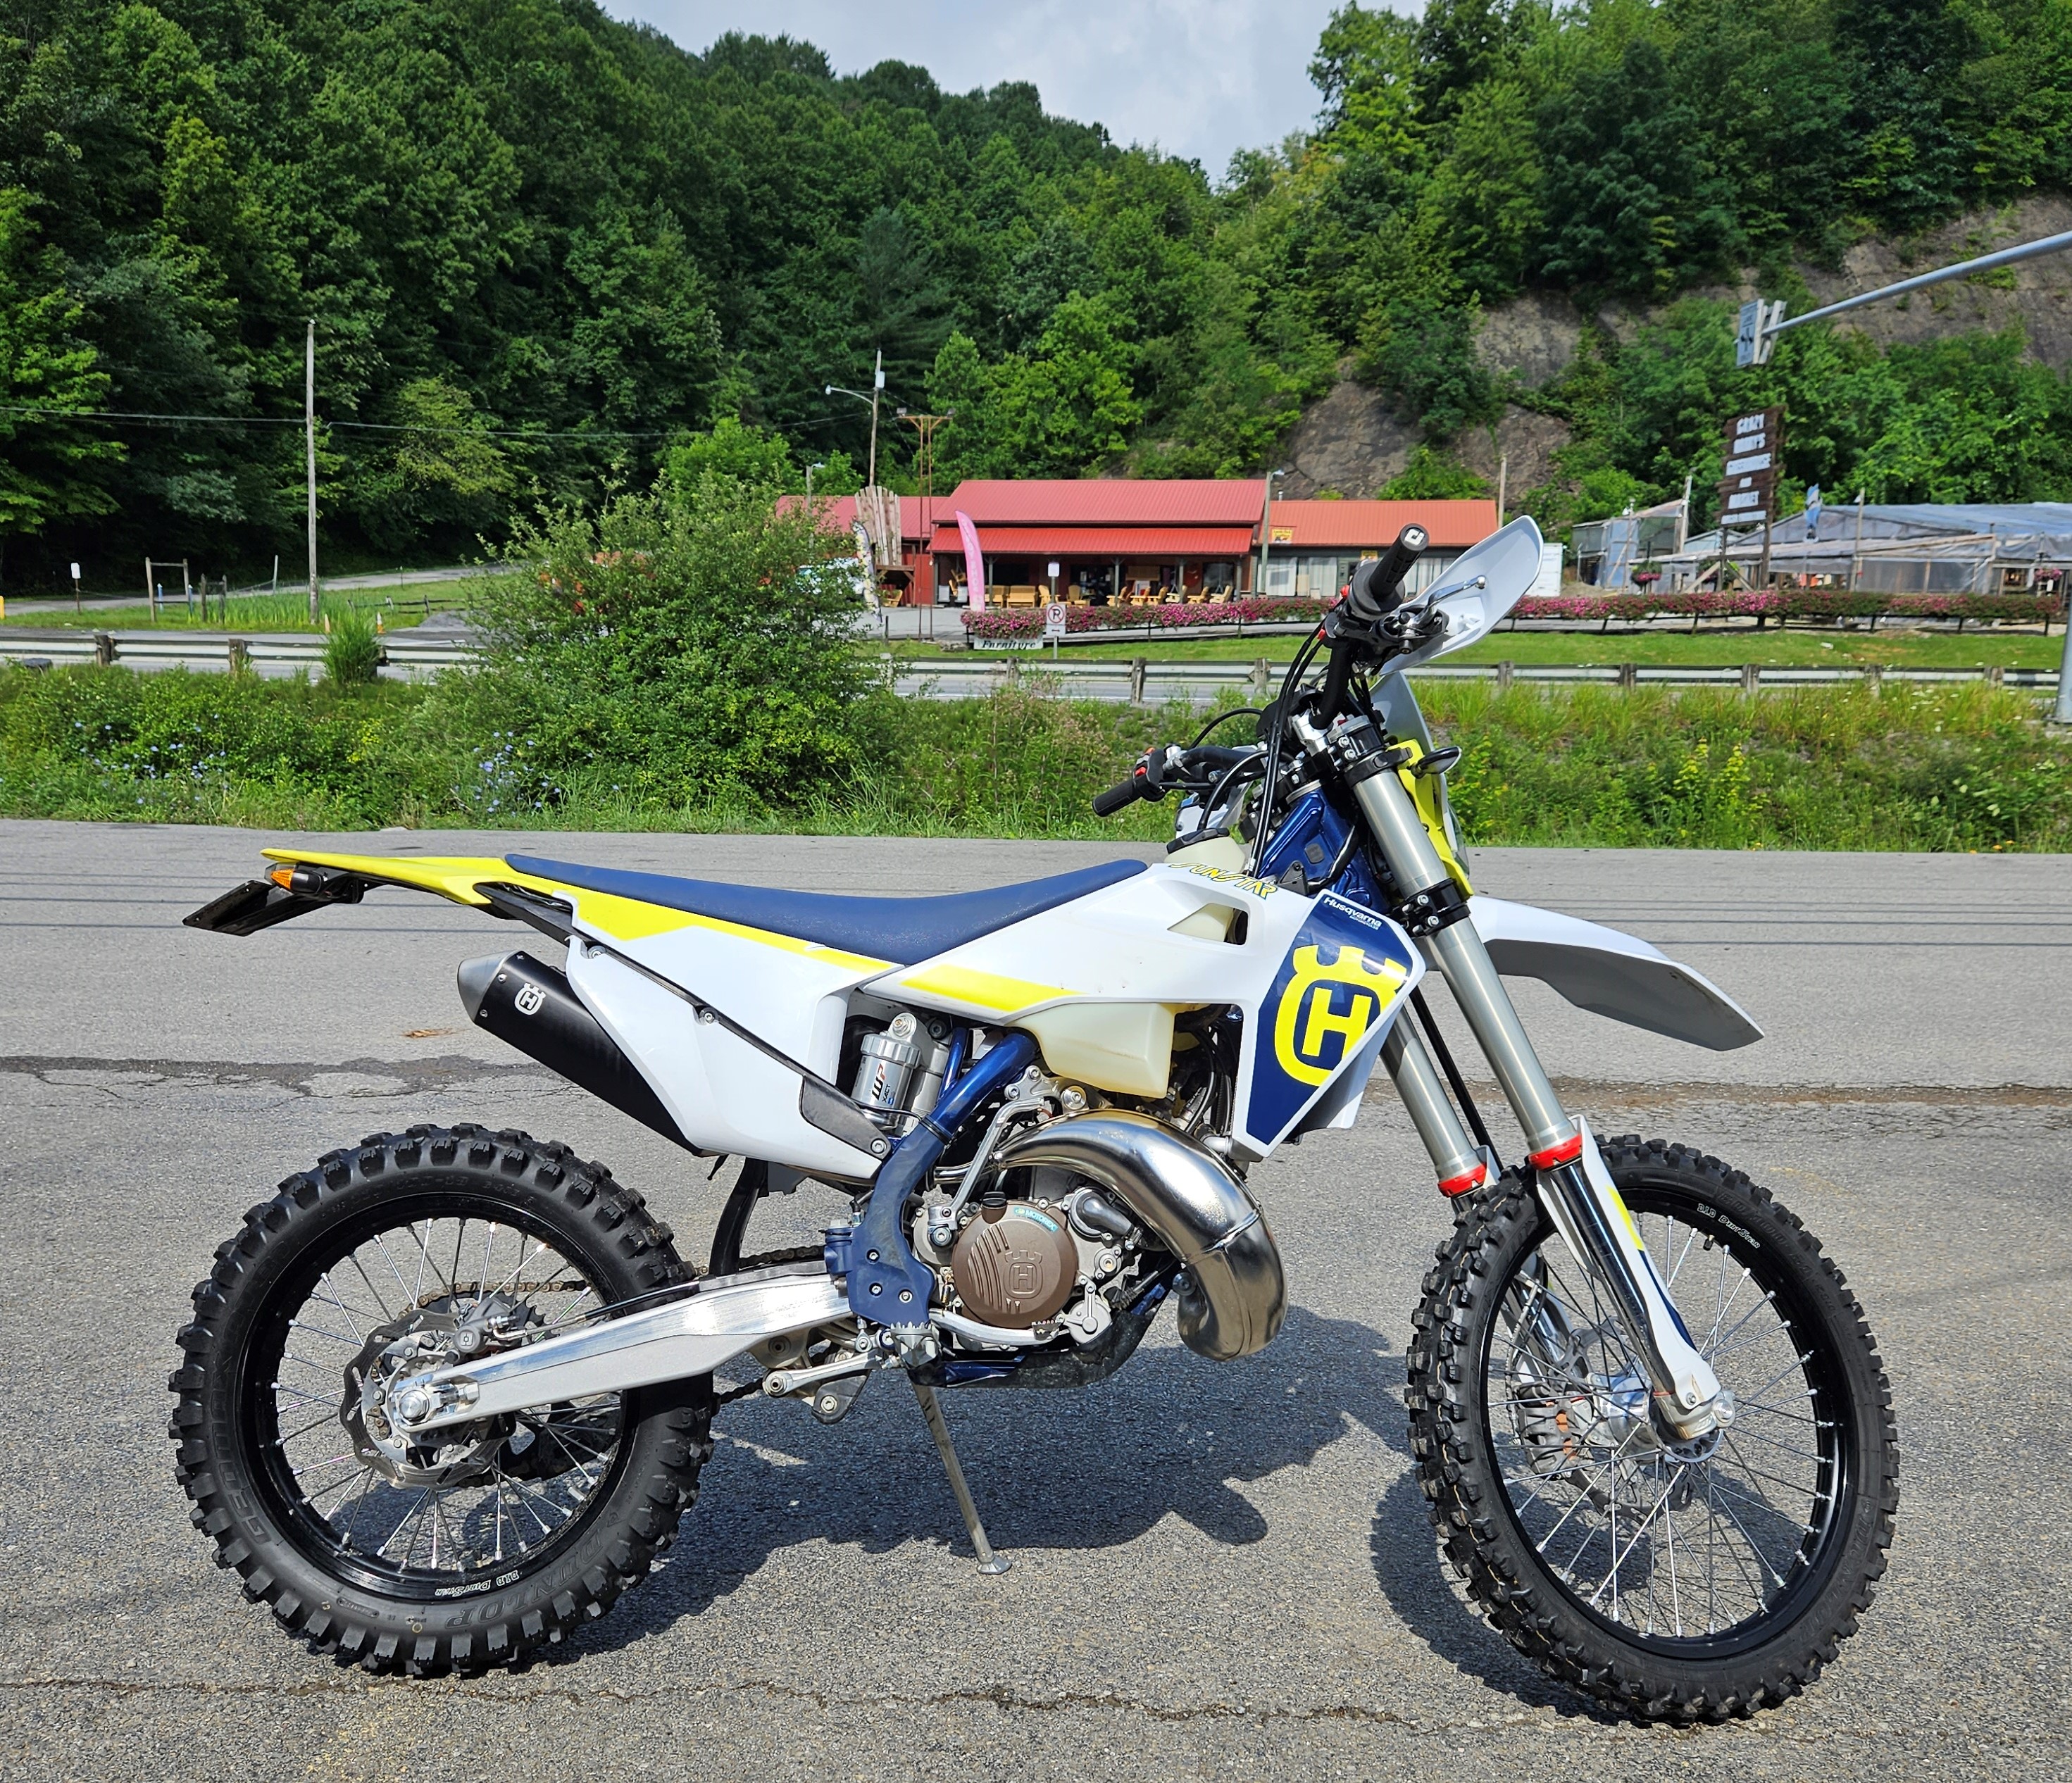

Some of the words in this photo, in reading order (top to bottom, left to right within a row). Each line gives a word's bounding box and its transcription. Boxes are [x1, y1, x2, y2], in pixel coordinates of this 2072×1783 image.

[982, 639, 1036, 649] Furniture
[1168, 863, 1278, 900] SUNSTAR
[1323, 896, 1382, 927] Husqvarna
[1025, 1210, 1059, 1232] MOTOREX
[445, 1529, 604, 1629] DUNLOP
